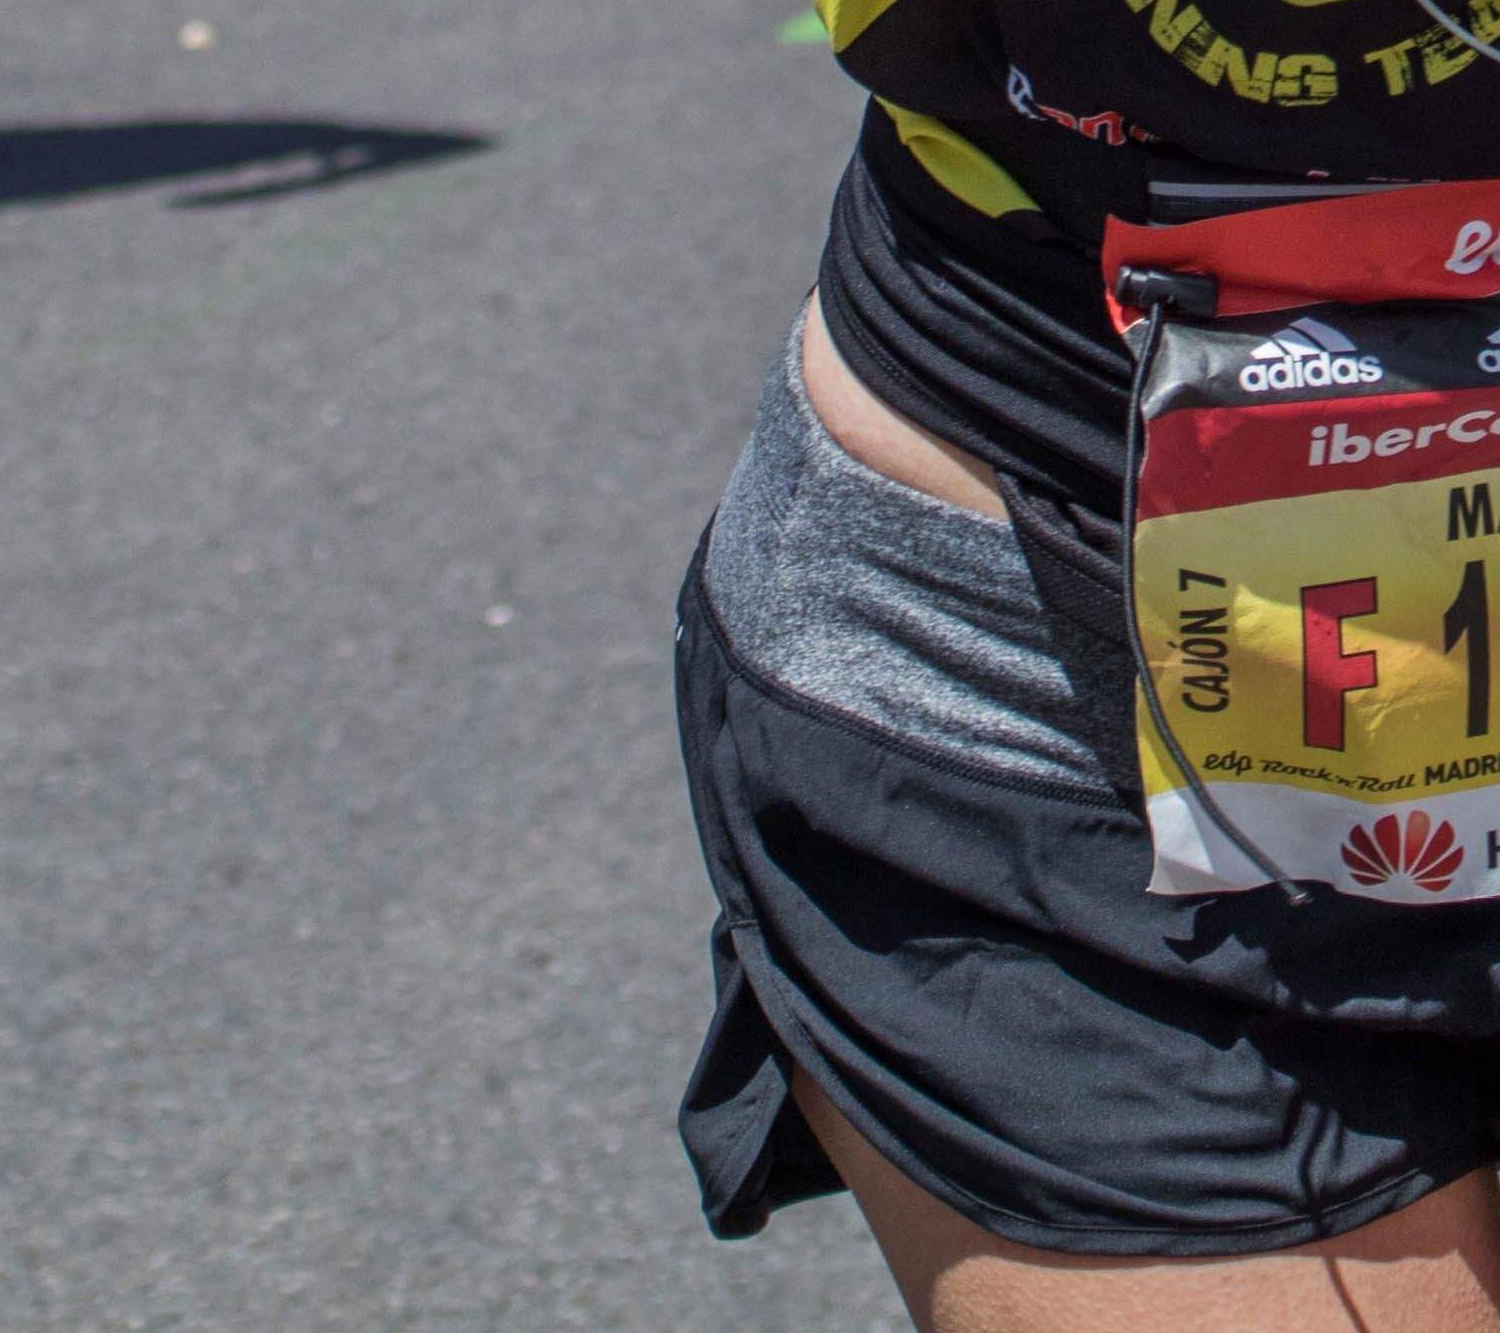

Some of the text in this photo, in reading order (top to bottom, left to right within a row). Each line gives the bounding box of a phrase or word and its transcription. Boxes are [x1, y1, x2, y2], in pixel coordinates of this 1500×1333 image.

[1238, 348, 1384, 393] adidas
[1168, 567, 1230, 714] CAJÓN 7
[1300, 575, 1379, 753] F
[1203, 750, 1253, 777] edp
